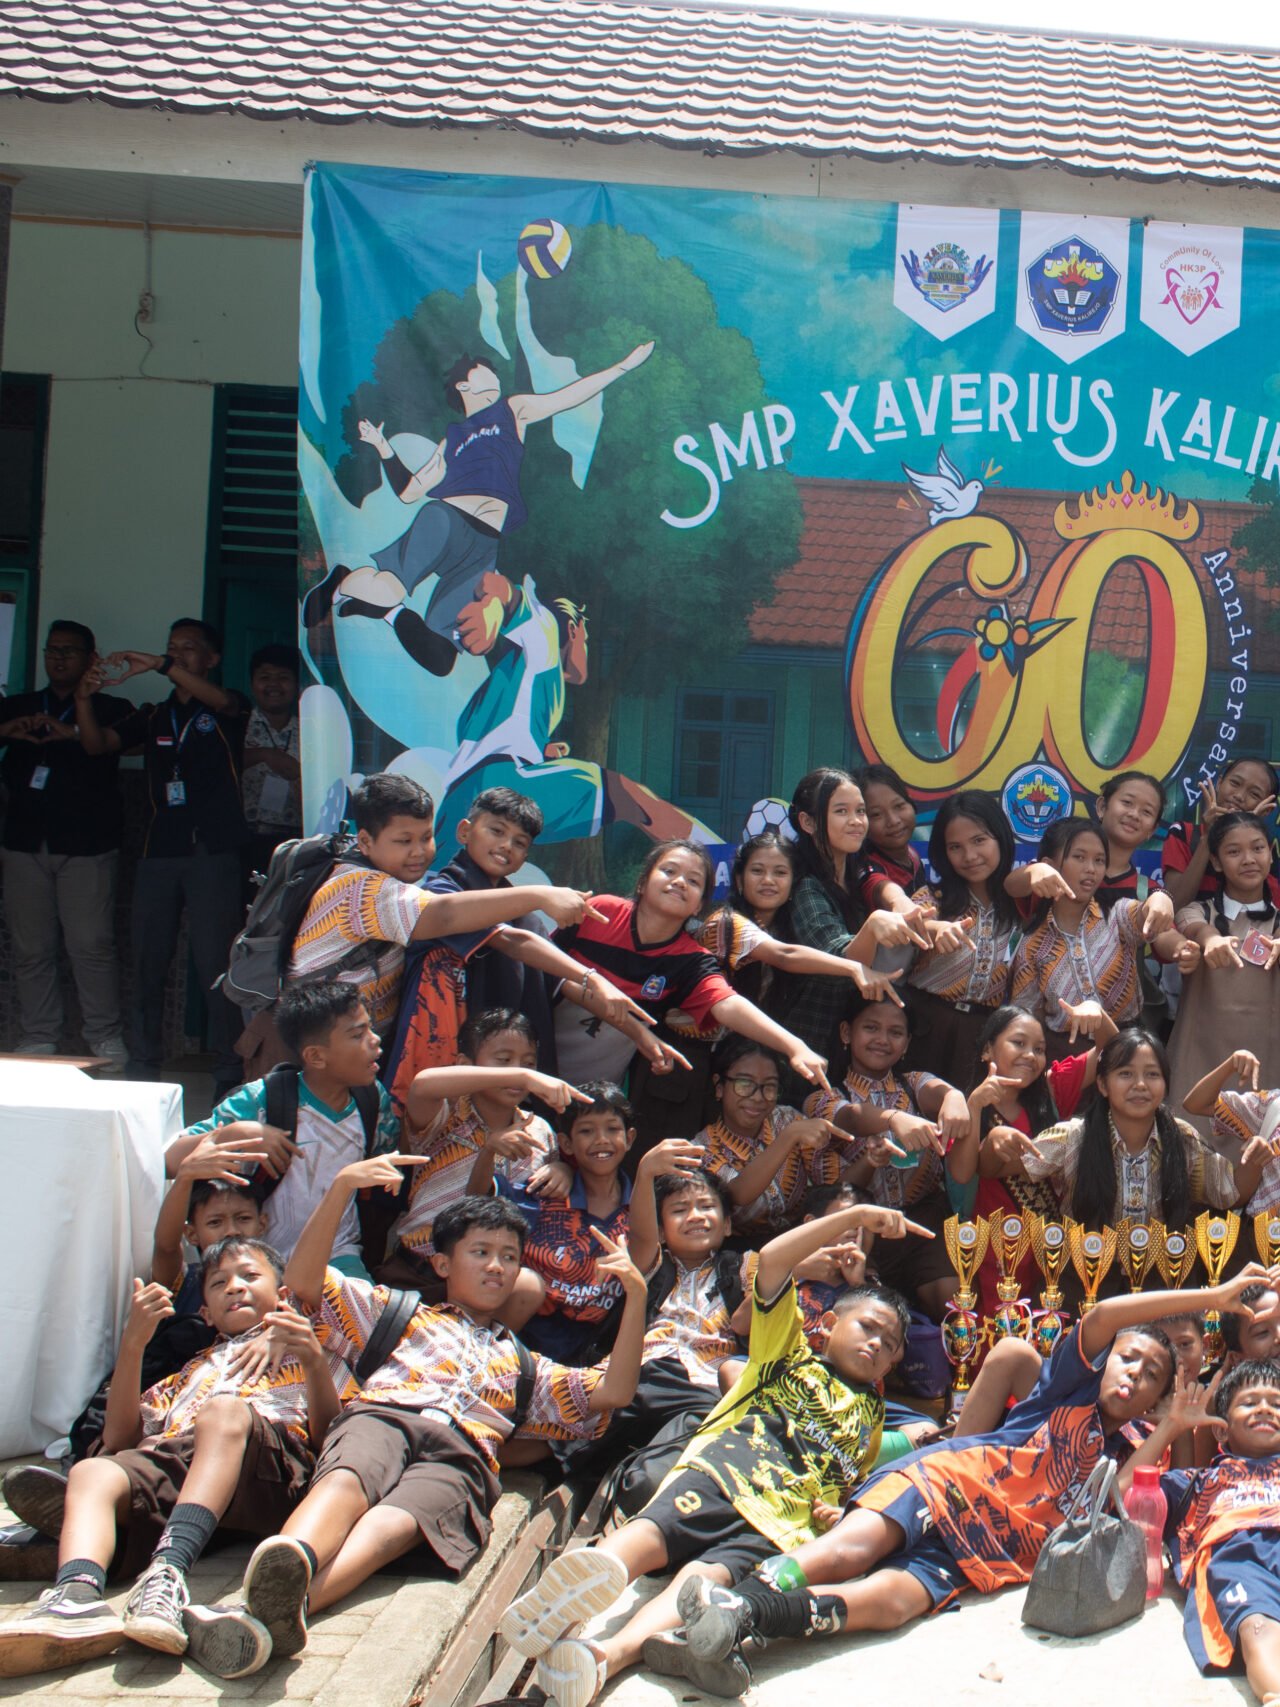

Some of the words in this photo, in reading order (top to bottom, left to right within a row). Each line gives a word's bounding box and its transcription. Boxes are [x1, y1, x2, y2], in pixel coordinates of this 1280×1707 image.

[1180, 263, 1206, 273] HK3P
[660, 404, 796, 529] SMP
[820, 373, 1118, 467] XAVERIUS
[1183, 550, 1252, 807] Anniversary
[1225, 1582, 1248, 1604] 4
